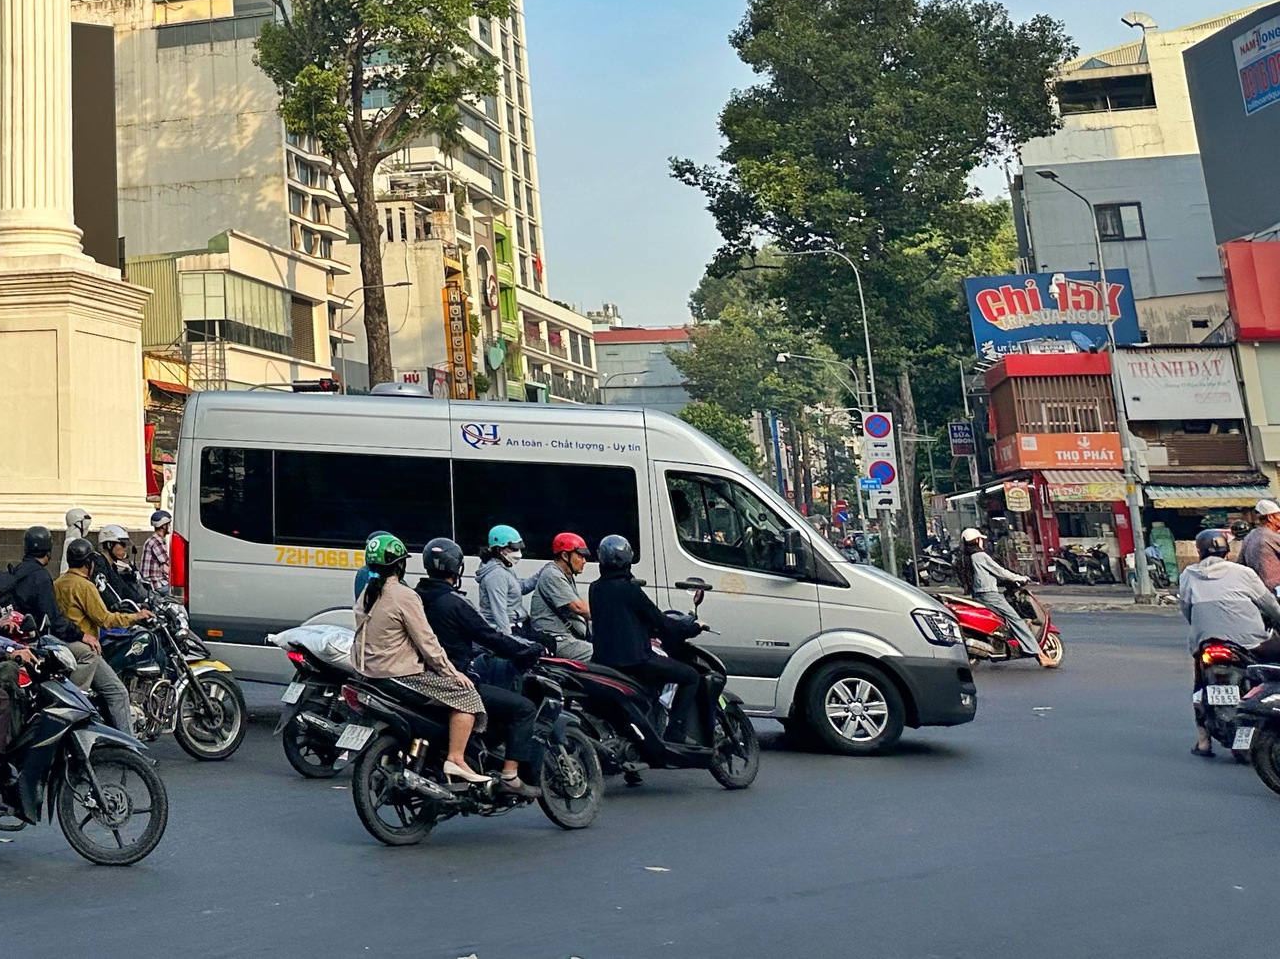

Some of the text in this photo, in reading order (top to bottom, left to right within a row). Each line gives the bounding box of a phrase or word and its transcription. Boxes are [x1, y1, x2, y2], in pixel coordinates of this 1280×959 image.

[975, 278, 1044, 324] Chỉ
[1128, 357, 1221, 380] THÀNH ĐẠT
[461, 423, 501, 450] QH
[506, 438, 641, 453] An toàn Chất lượng Uy tín
[1055, 448, 1115, 463] THỌ PHÁT
[275, 547, 365, 569] 72H-068.5
